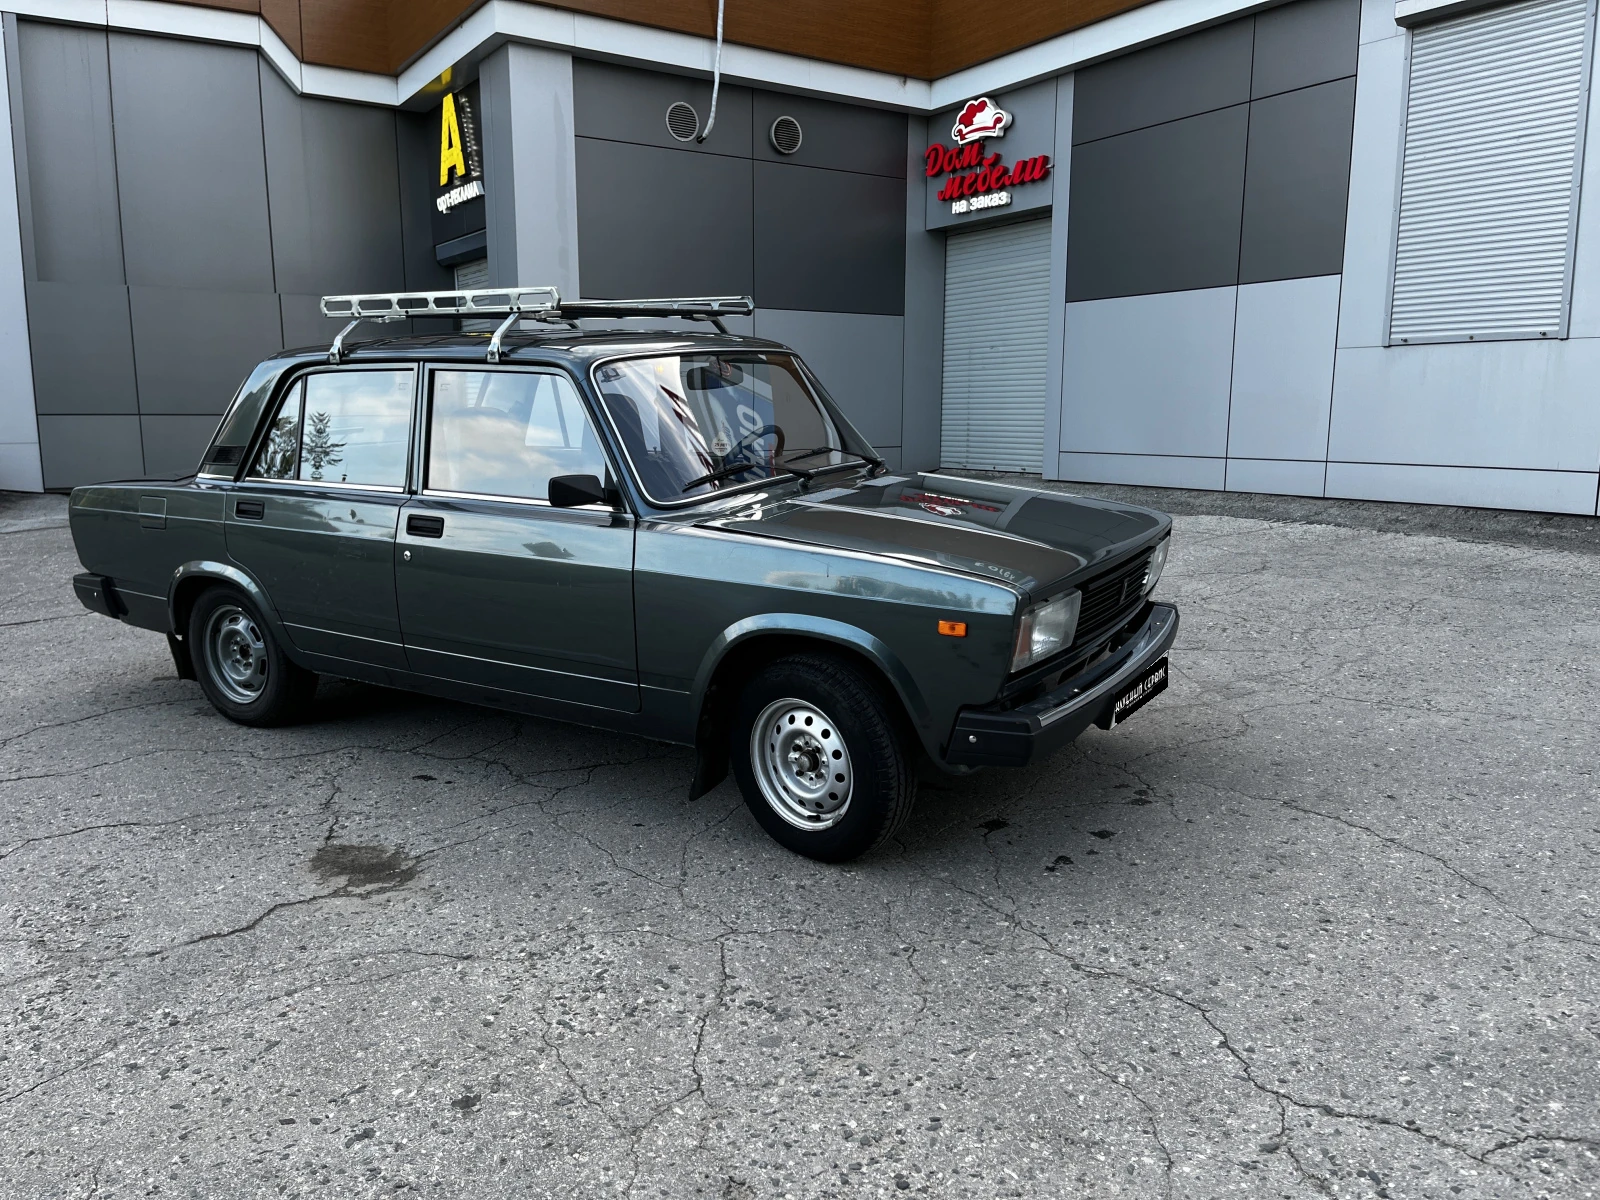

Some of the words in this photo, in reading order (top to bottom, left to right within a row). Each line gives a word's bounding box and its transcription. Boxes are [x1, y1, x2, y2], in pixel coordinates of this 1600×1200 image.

[924, 142, 985, 177] Дом
[937, 152, 1050, 201] мебели
[951, 199, 968, 214] на
[970, 191, 1009, 211] заказ
